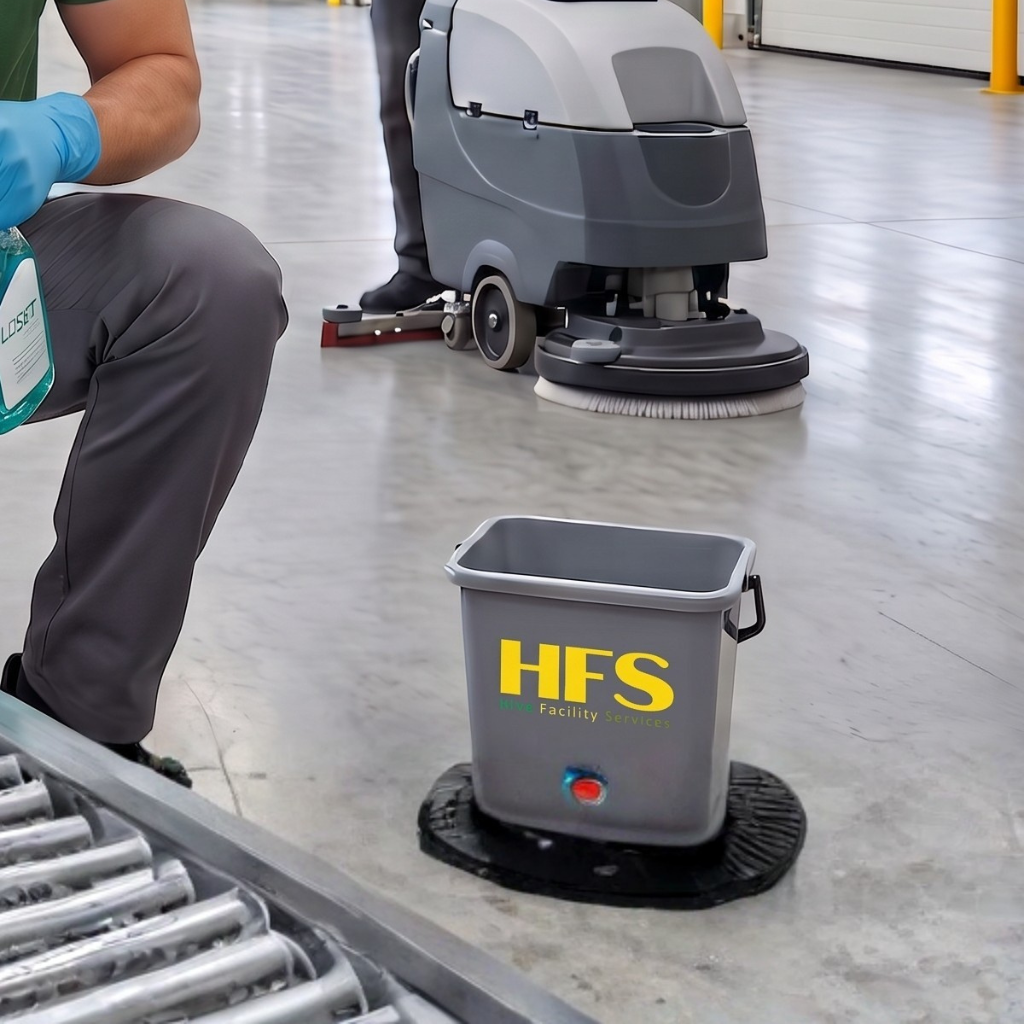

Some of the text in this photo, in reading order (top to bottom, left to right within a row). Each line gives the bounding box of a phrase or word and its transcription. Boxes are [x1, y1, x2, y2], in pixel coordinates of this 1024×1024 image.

[500, 638, 675, 712] HFS
[499, 698, 670, 728] Hive Facility Services
